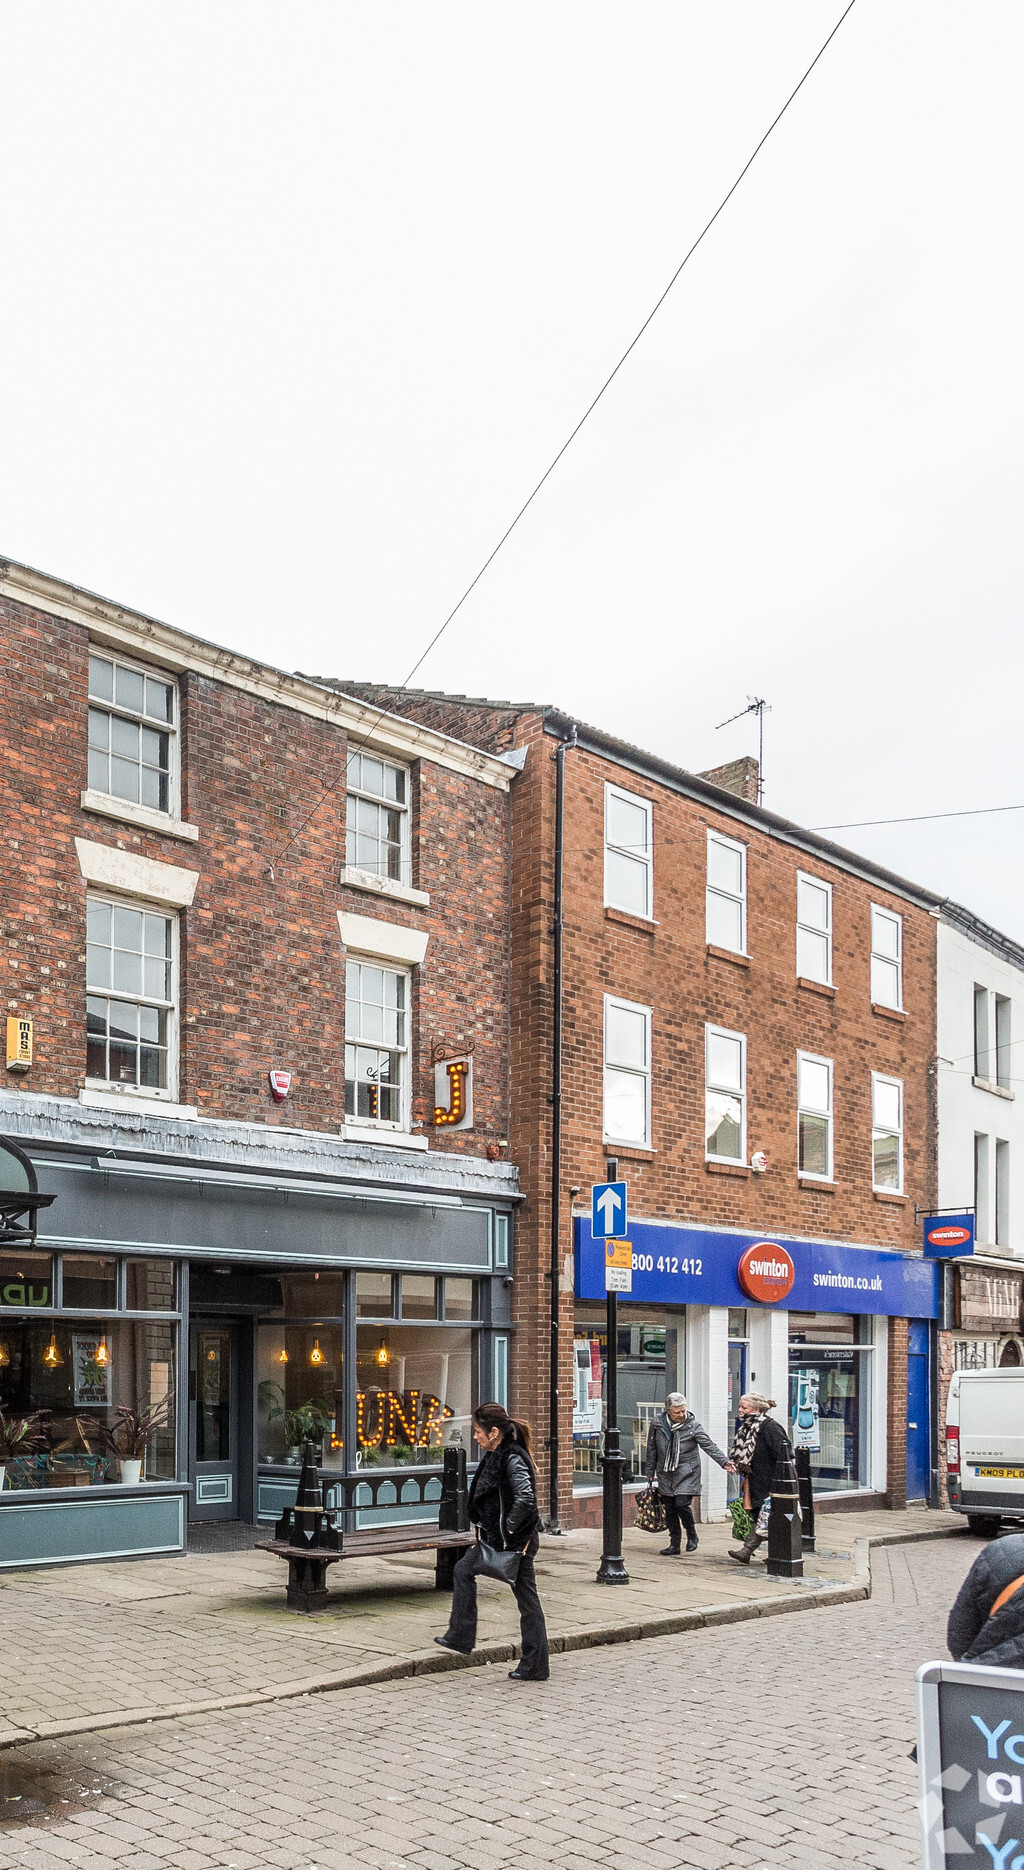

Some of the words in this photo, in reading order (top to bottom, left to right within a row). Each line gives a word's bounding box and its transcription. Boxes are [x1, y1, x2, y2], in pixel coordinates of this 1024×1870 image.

[932, 1231, 964, 1239] swinton
[656, 1255, 679, 1273] 412
[681, 1258, 703, 1275] 412
[749, 1257, 789, 1278] swinton
[813, 1270, 883, 1291] swinton.co.uk
